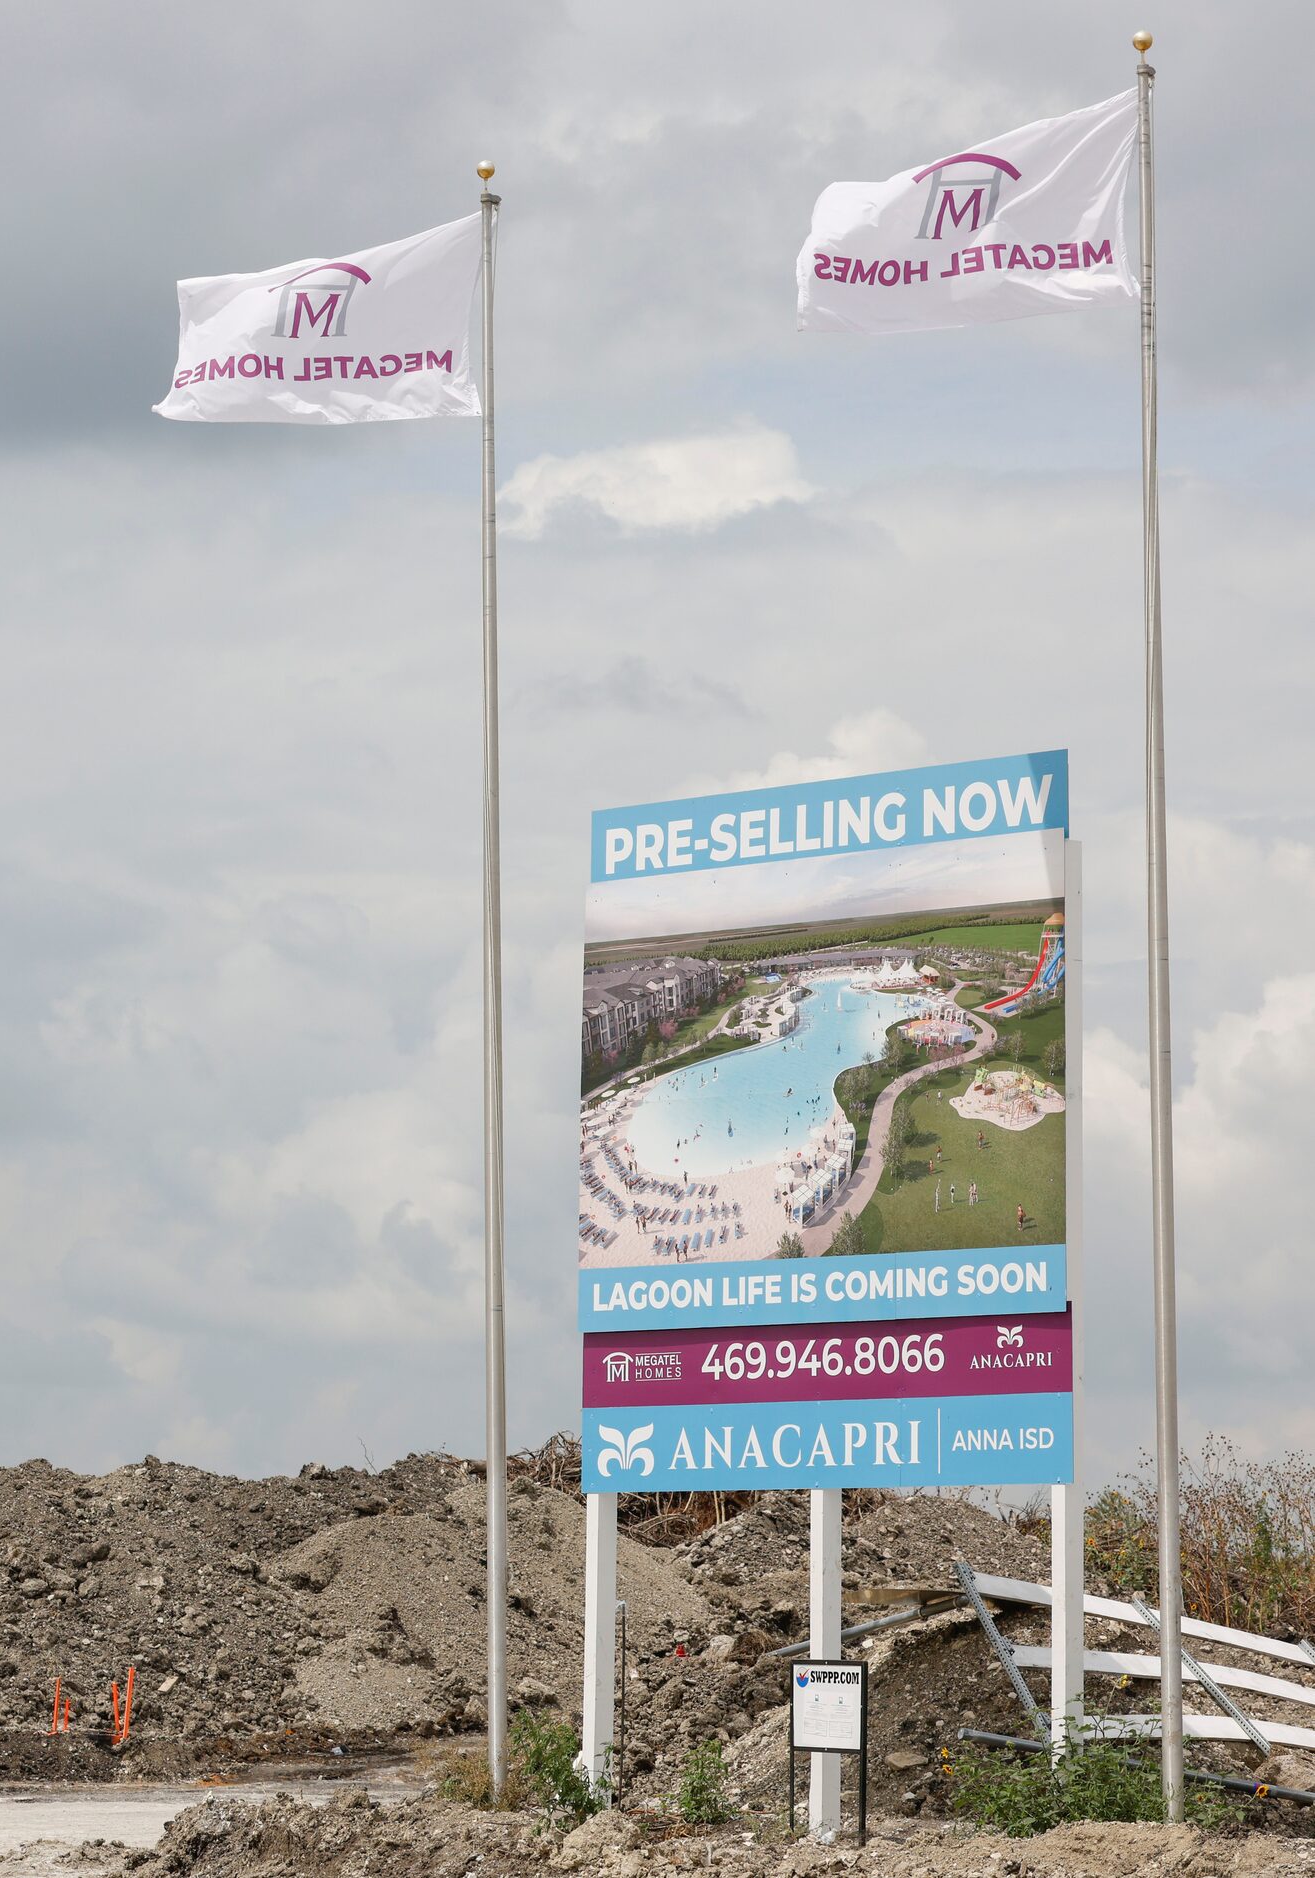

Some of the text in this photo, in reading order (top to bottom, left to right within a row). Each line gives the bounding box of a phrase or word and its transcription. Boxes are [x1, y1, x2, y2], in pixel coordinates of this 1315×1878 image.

[605, 773, 1054, 876] PRE-SELLING NOW
[592, 1261, 1048, 1313] LAGOON LIFE IS COMING SOON
[635, 1354, 682, 1367] MEGATEL
[700, 1333, 946, 1381] 469.946.8066
[969, 1351, 1053, 1370] ANACAPRI
[635, 1366, 682, 1379] HOMES
[667, 1420, 922, 1471] ANACAPRI
[951, 1427, 1054, 1452] ANNA ISD
[810, 1670, 860, 1685] SWPPP.COM
